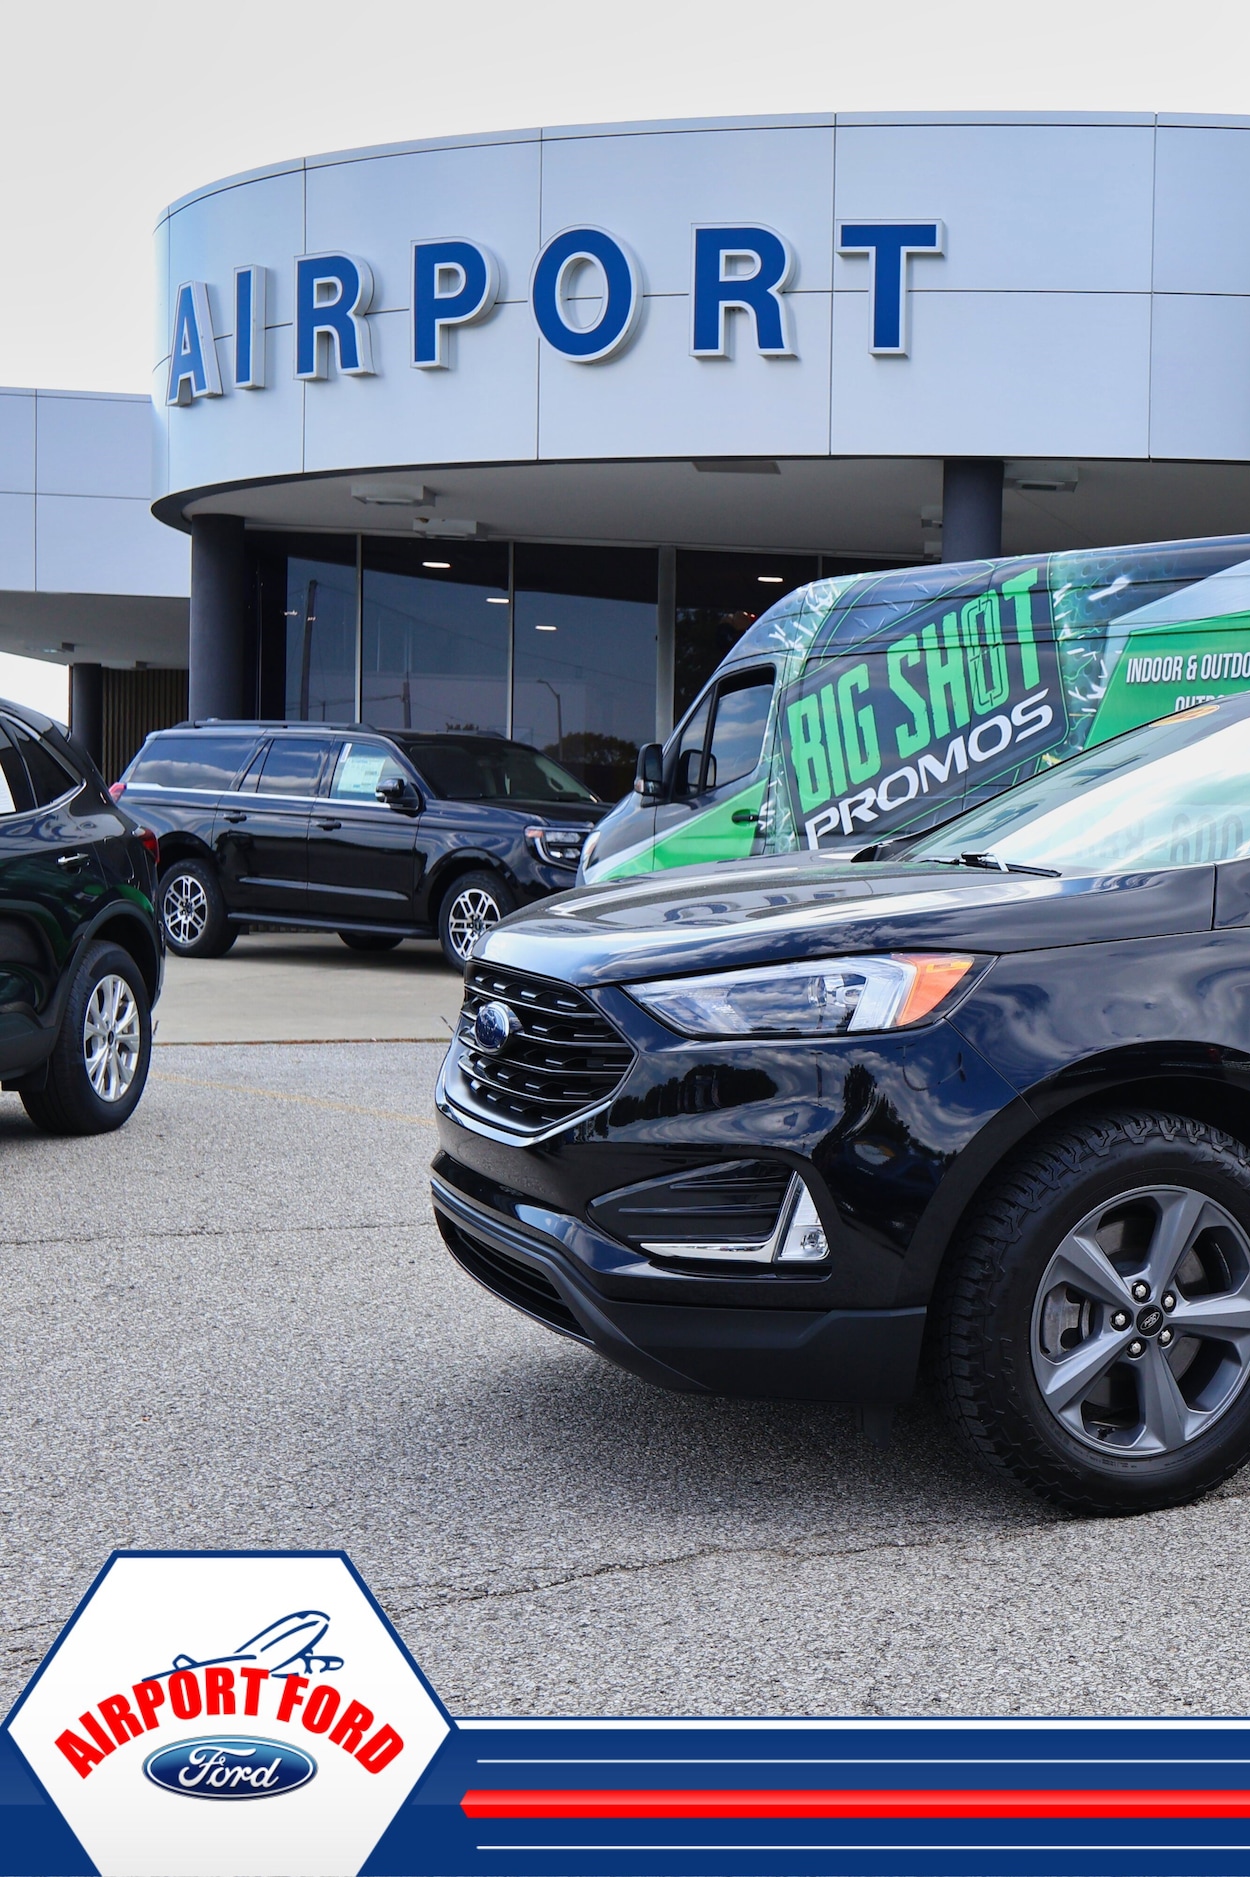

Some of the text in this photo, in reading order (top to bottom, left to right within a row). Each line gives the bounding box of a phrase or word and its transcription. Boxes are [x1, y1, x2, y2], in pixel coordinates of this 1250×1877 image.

[167, 218, 944, 408] AIRPORT
[787, 568, 1040, 815] BIG SHOT
[1126, 656, 1184, 684] INDOOR
[1186, 654, 1198, 681] &
[804, 687, 1054, 850] PROMOS
